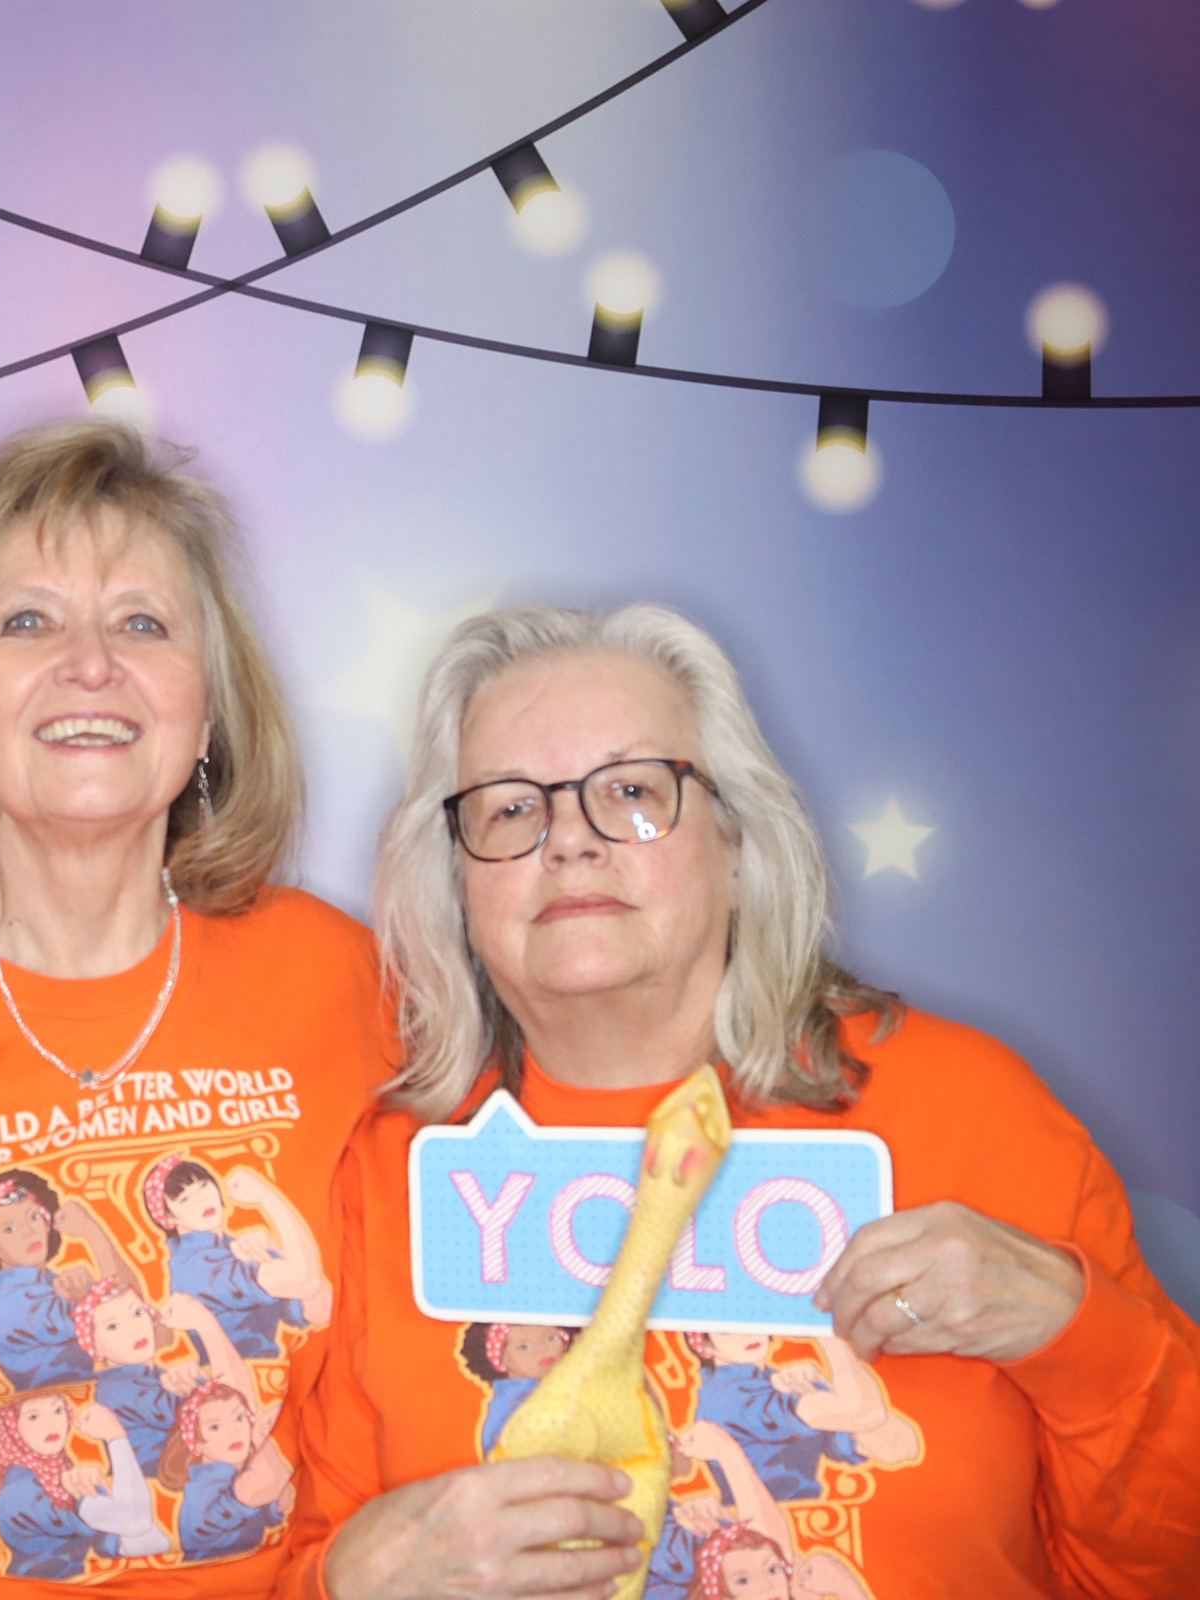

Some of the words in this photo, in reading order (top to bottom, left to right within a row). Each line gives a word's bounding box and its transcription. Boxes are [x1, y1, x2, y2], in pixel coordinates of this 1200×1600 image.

[21, 1104, 138, 1156] WOMEN
[142, 1099, 212, 1134] AND
[218, 1093, 301, 1127] GIRLS
[48, 1105, 71, 1132] A
[77, 1071, 179, 1119] BETTER
[179, 1067, 293, 1098] WORLD
[449, 1171, 848, 1296] YOLO
